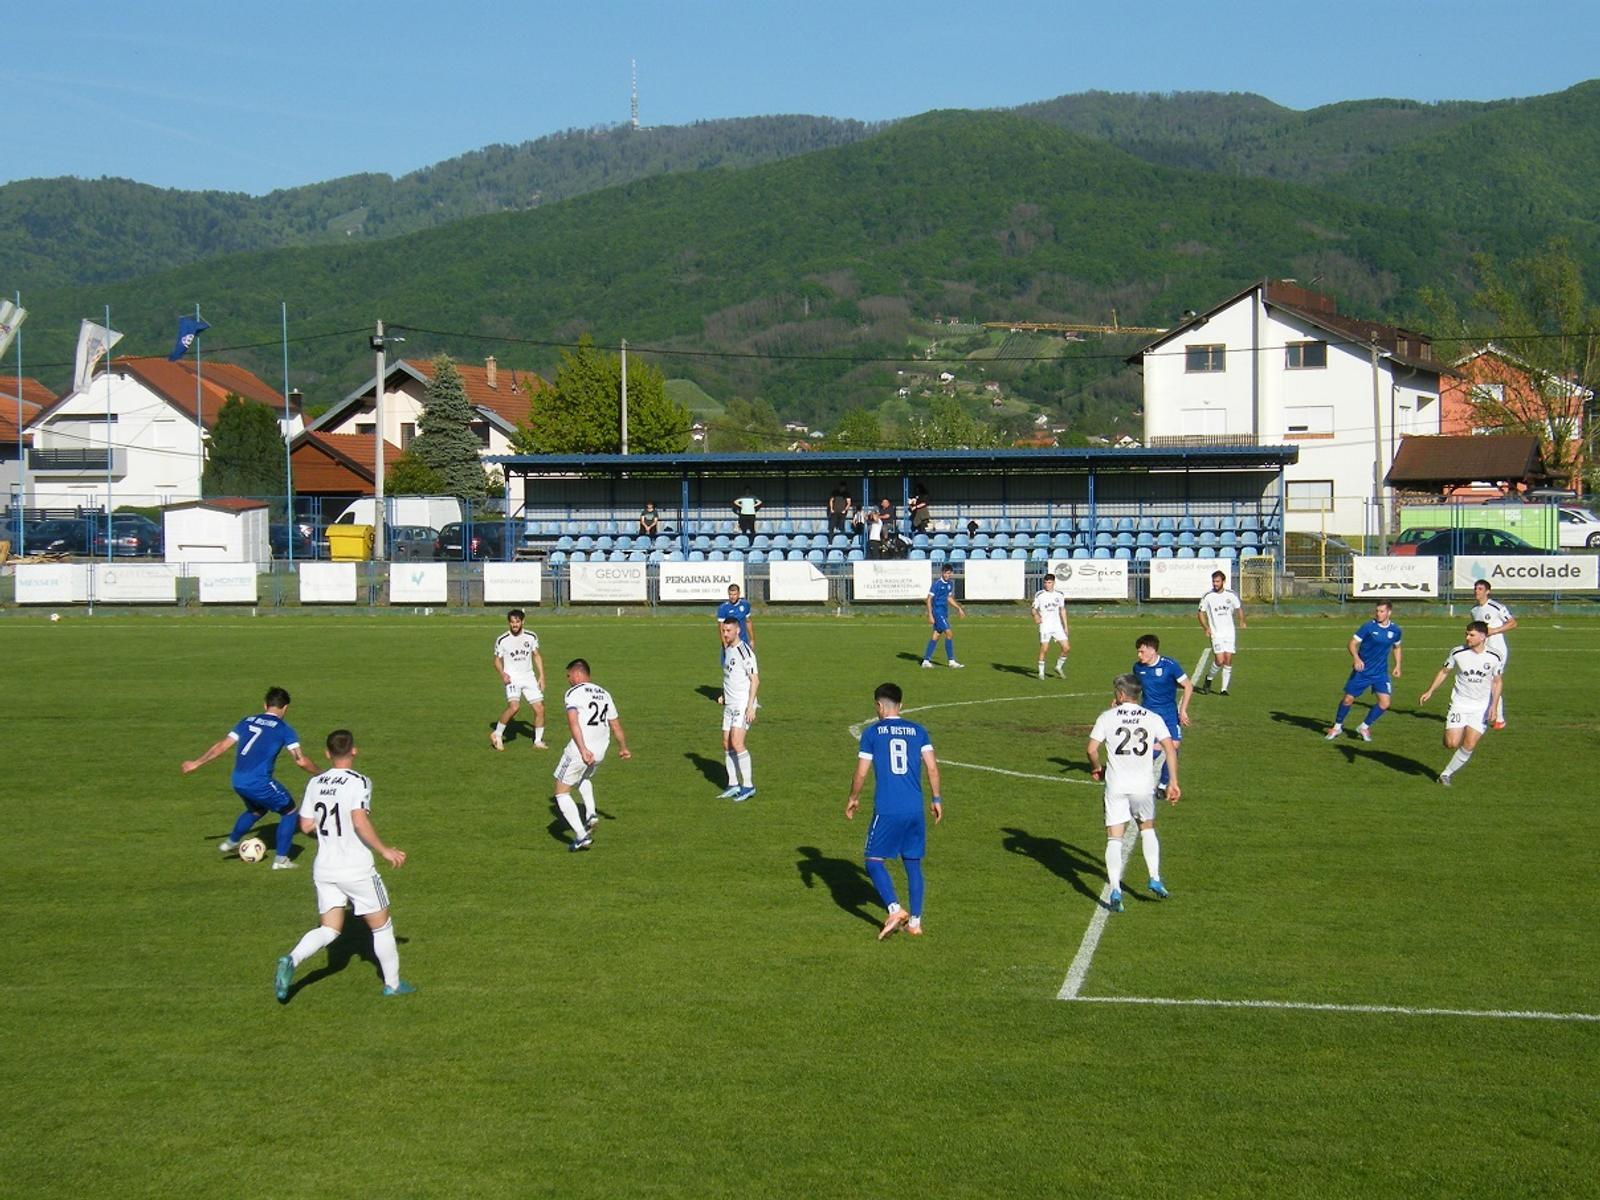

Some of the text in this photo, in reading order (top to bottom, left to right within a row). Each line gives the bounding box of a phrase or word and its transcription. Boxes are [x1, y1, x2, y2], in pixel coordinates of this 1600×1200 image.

[595, 568, 641, 579] GEOVID
[1491, 563, 1582, 578] Accolade
[665, 575, 732, 584] PEKARNA KAJ
[587, 701, 609, 727] 24
[1450, 713, 1461, 723] 20
[890, 725, 918, 737] BISTRA
[240, 725, 263, 756] 7
[1115, 726, 1149, 757] 23
[890, 738, 908, 775] 8
[317, 776, 349, 786] NK GAJ
[314, 801, 342, 837] 21
